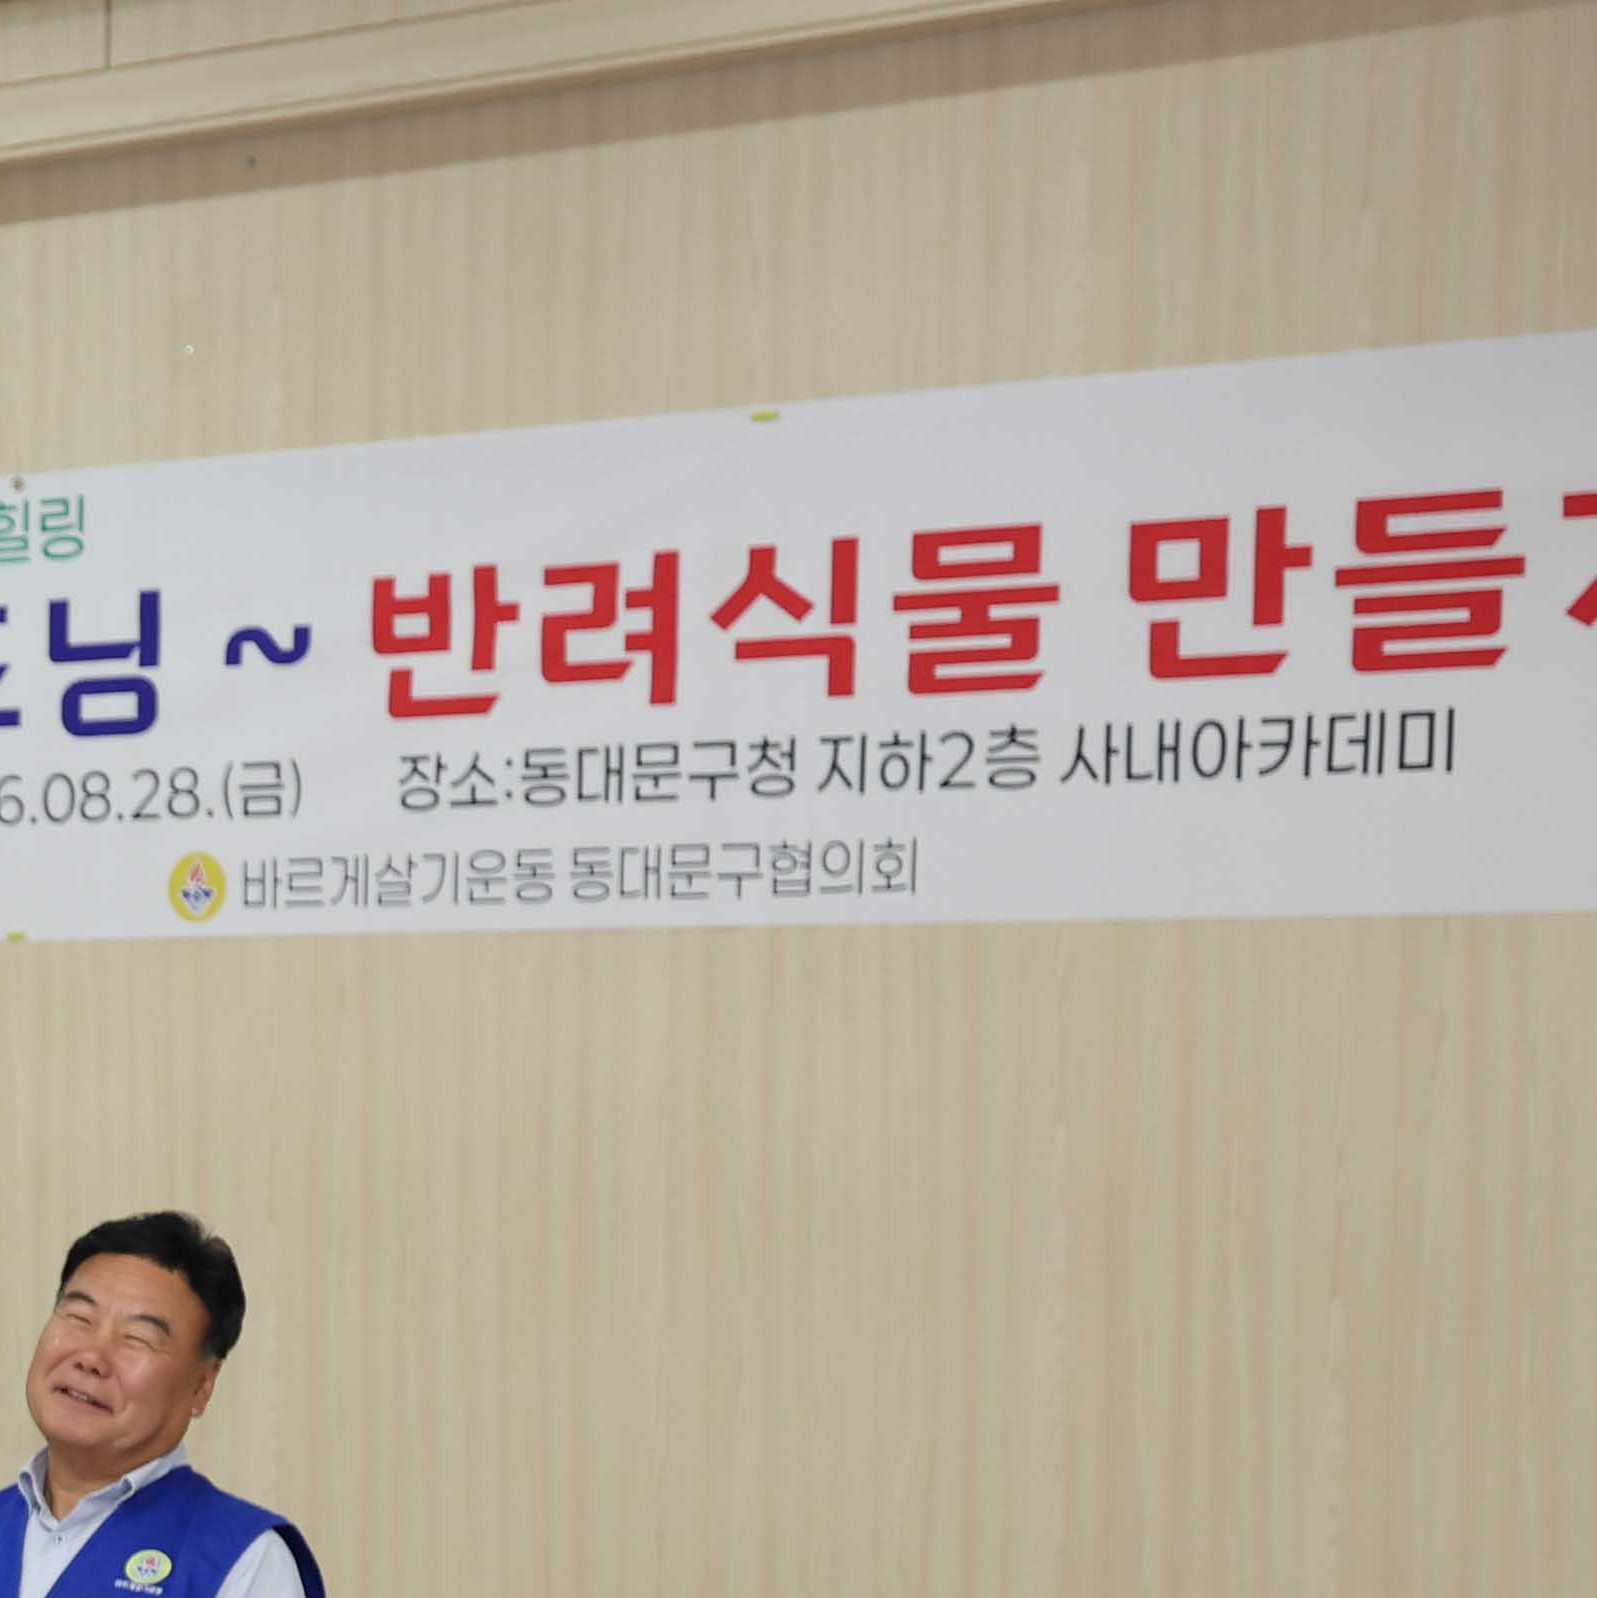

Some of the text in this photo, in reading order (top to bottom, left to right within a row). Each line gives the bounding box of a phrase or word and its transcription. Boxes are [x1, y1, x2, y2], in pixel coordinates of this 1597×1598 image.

[369, 521, 1062, 720] 반려식물
[1126, 486, 1597, 682] 만들
[398, 735, 797, 813] 장소:동대문구청
[816, 722, 1042, 797] 지하2층
[1060, 705, 1457, 788] 사내아카데미
[242, 836, 920, 909] 바르게살기운동 동대문구협의회
